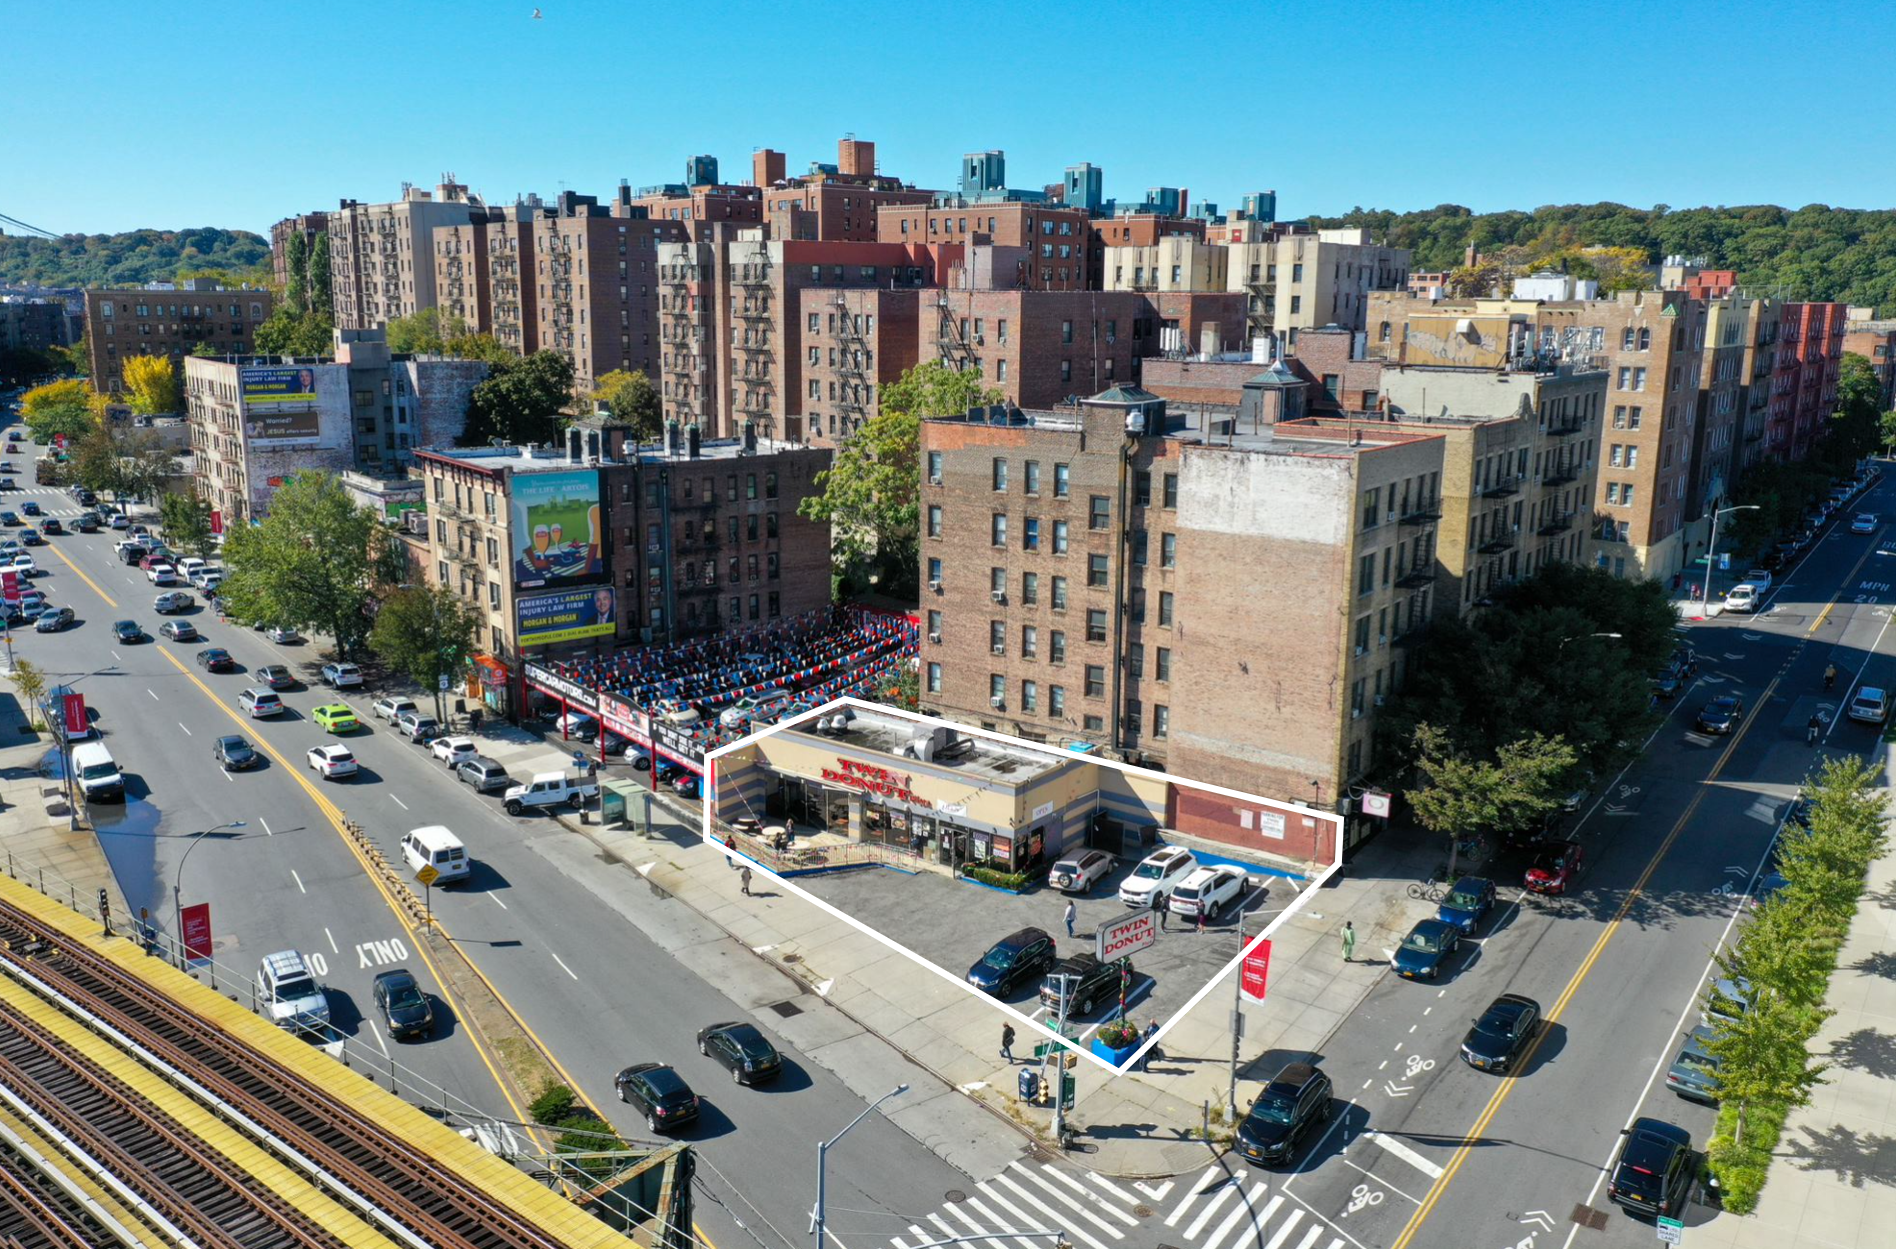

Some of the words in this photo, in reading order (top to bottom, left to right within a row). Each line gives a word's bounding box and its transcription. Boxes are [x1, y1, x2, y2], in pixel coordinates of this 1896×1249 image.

[522, 487, 537, 495] THE
[539, 485, 555, 494] LIFE
[1860, 581, 1891, 592] MPH
[519, 596, 559, 608] AMERICA'S
[560, 592, 592, 602] LARGEST
[1854, 594, 1878, 604] 20
[519, 606, 547, 616] INJURY
[548, 604, 565, 612] LAW
[566, 601, 585, 609] FIRM
[523, 617, 547, 628] MORGAN
[553, 613, 577, 623] MORGAN
[689, 748, 695, 759] IT
[837, 757, 913, 790] TWIN
[820, 767, 911, 801] DONUT
[1110, 916, 1149, 939] TWIN
[1104, 927, 1154, 954] DONUT
[355, 938, 409, 969] ONLY
[1661, 1234, 1675, 1242] LANE
